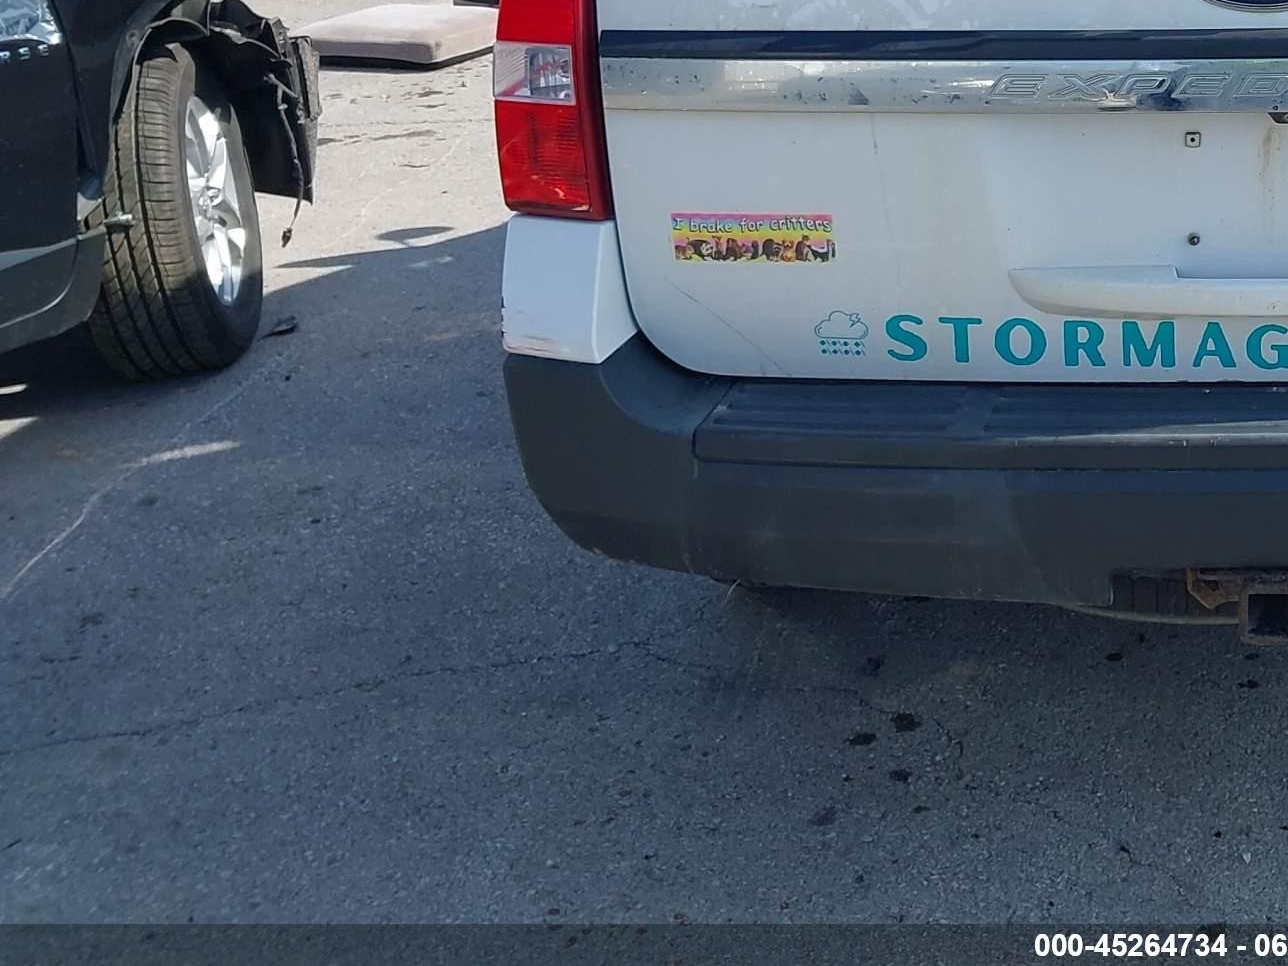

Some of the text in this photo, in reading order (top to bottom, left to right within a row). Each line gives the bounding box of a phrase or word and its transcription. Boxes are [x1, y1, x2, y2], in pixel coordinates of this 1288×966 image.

[673, 214, 832, 233] I brake for critters
